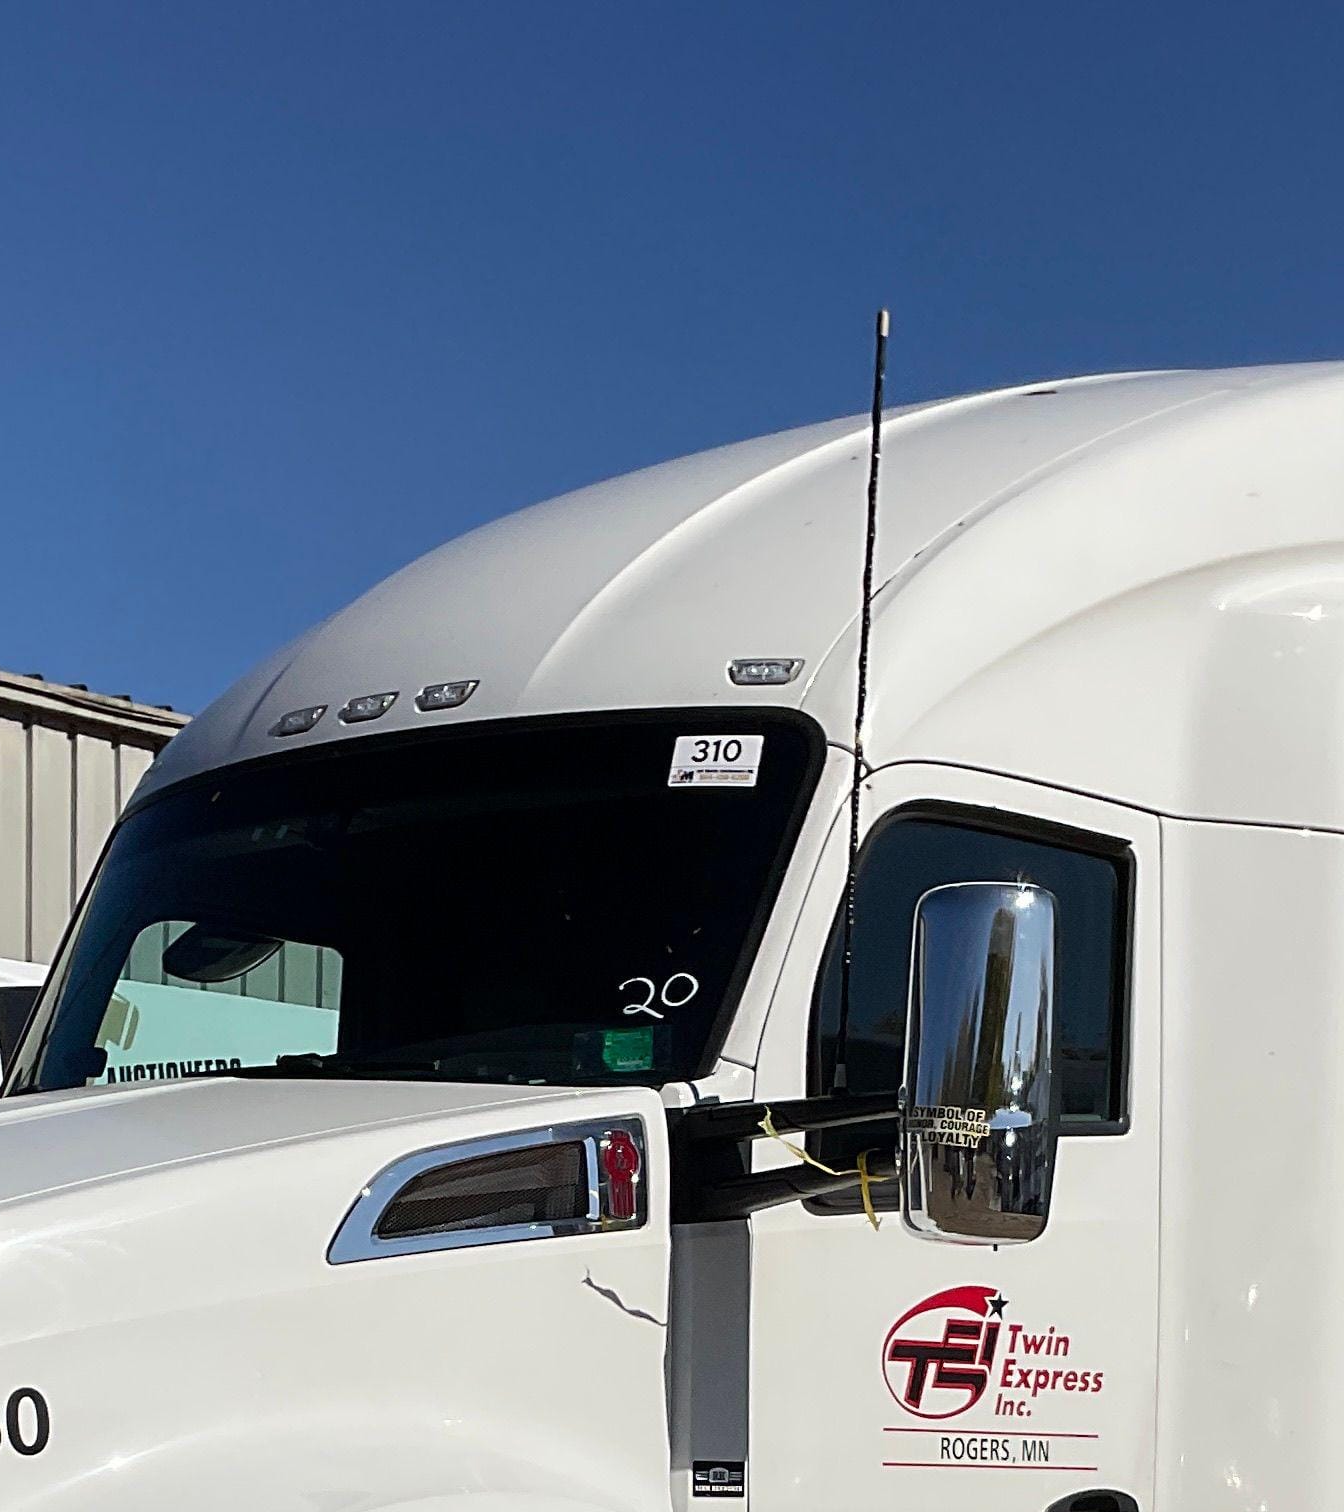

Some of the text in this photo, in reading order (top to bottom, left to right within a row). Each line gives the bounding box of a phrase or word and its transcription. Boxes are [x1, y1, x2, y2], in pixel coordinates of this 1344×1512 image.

[690, 739, 742, 762] 310
[618, 972, 699, 1019] 20
[913, 1106, 962, 1121] SYMBOL
[967, 1110, 984, 1122] OF
[922, 1131, 981, 1147] LOYALTY
[940, 1120, 989, 1135] COURAGE
[1008, 1324, 1070, 1356] Twin
[1000, 1358, 1103, 1398] Express
[995, 1393, 1032, 1417] Inc.
[940, 1436, 1050, 1463] ROGERS, MN
